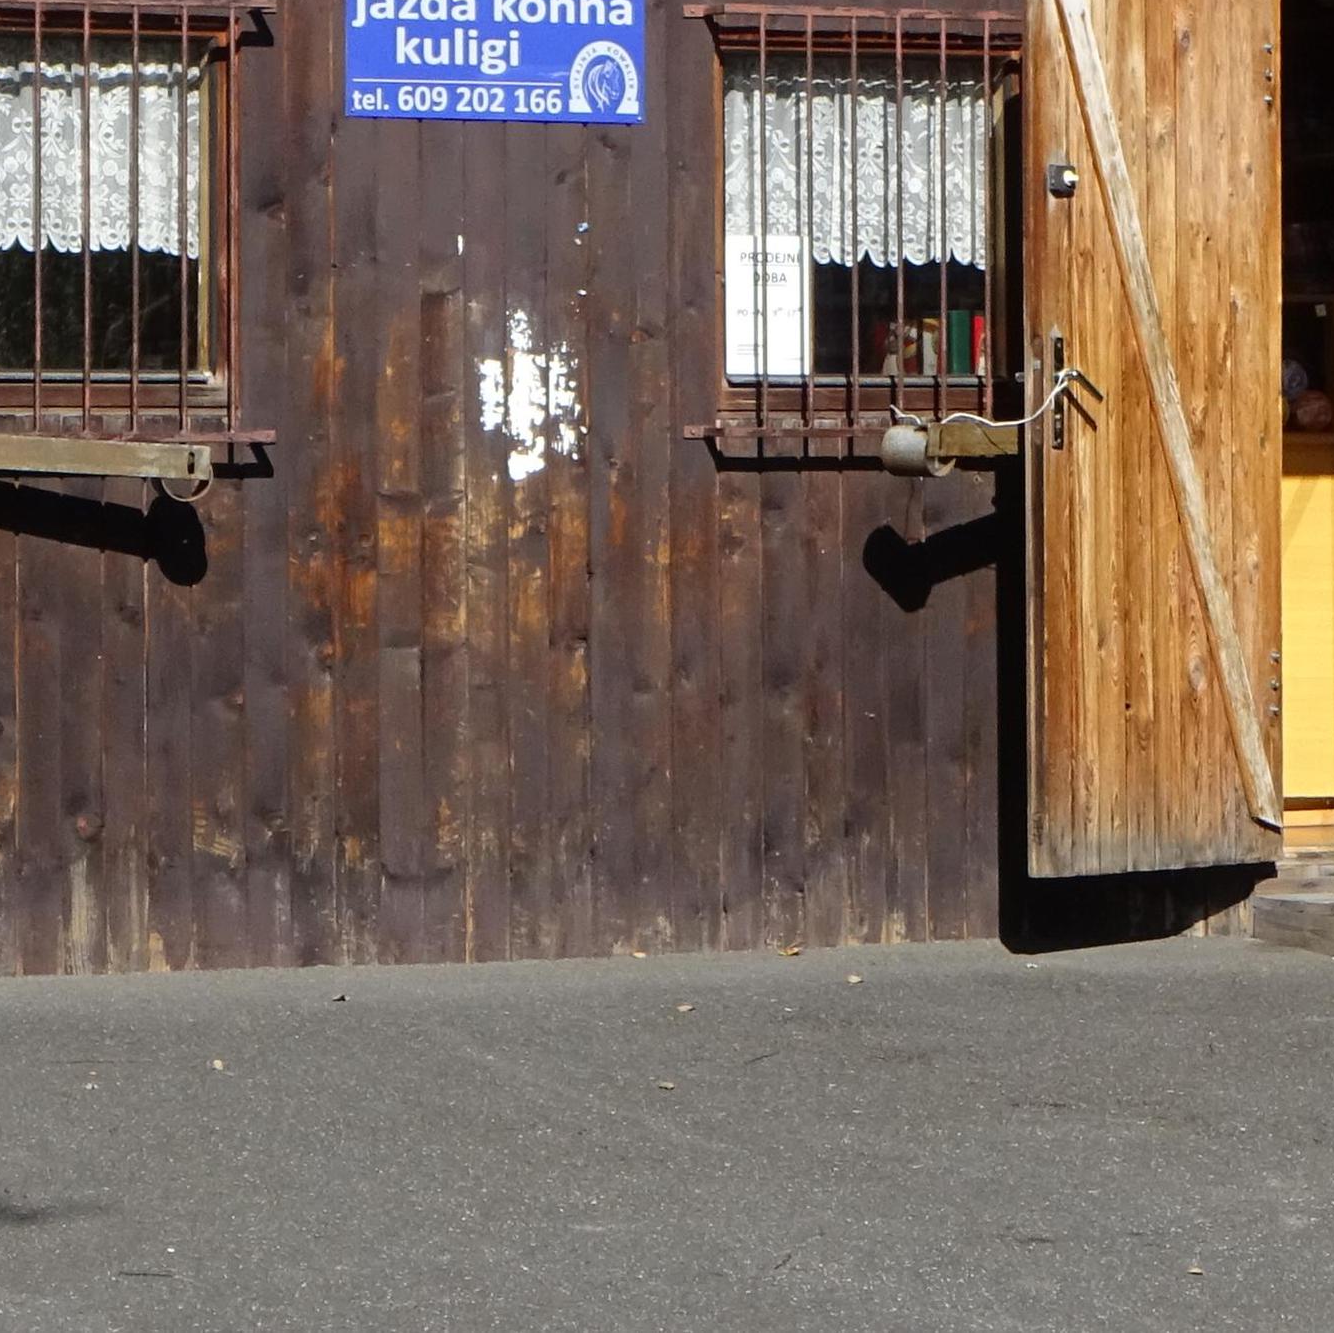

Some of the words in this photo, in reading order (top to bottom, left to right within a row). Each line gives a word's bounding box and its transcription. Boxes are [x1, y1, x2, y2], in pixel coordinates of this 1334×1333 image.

[396, 26, 520, 75] kuligi
[351, 87, 389, 111] tel.
[397, 86, 448, 112] 609
[456, 87, 506, 113] 202
[513, 89, 563, 114] 166
